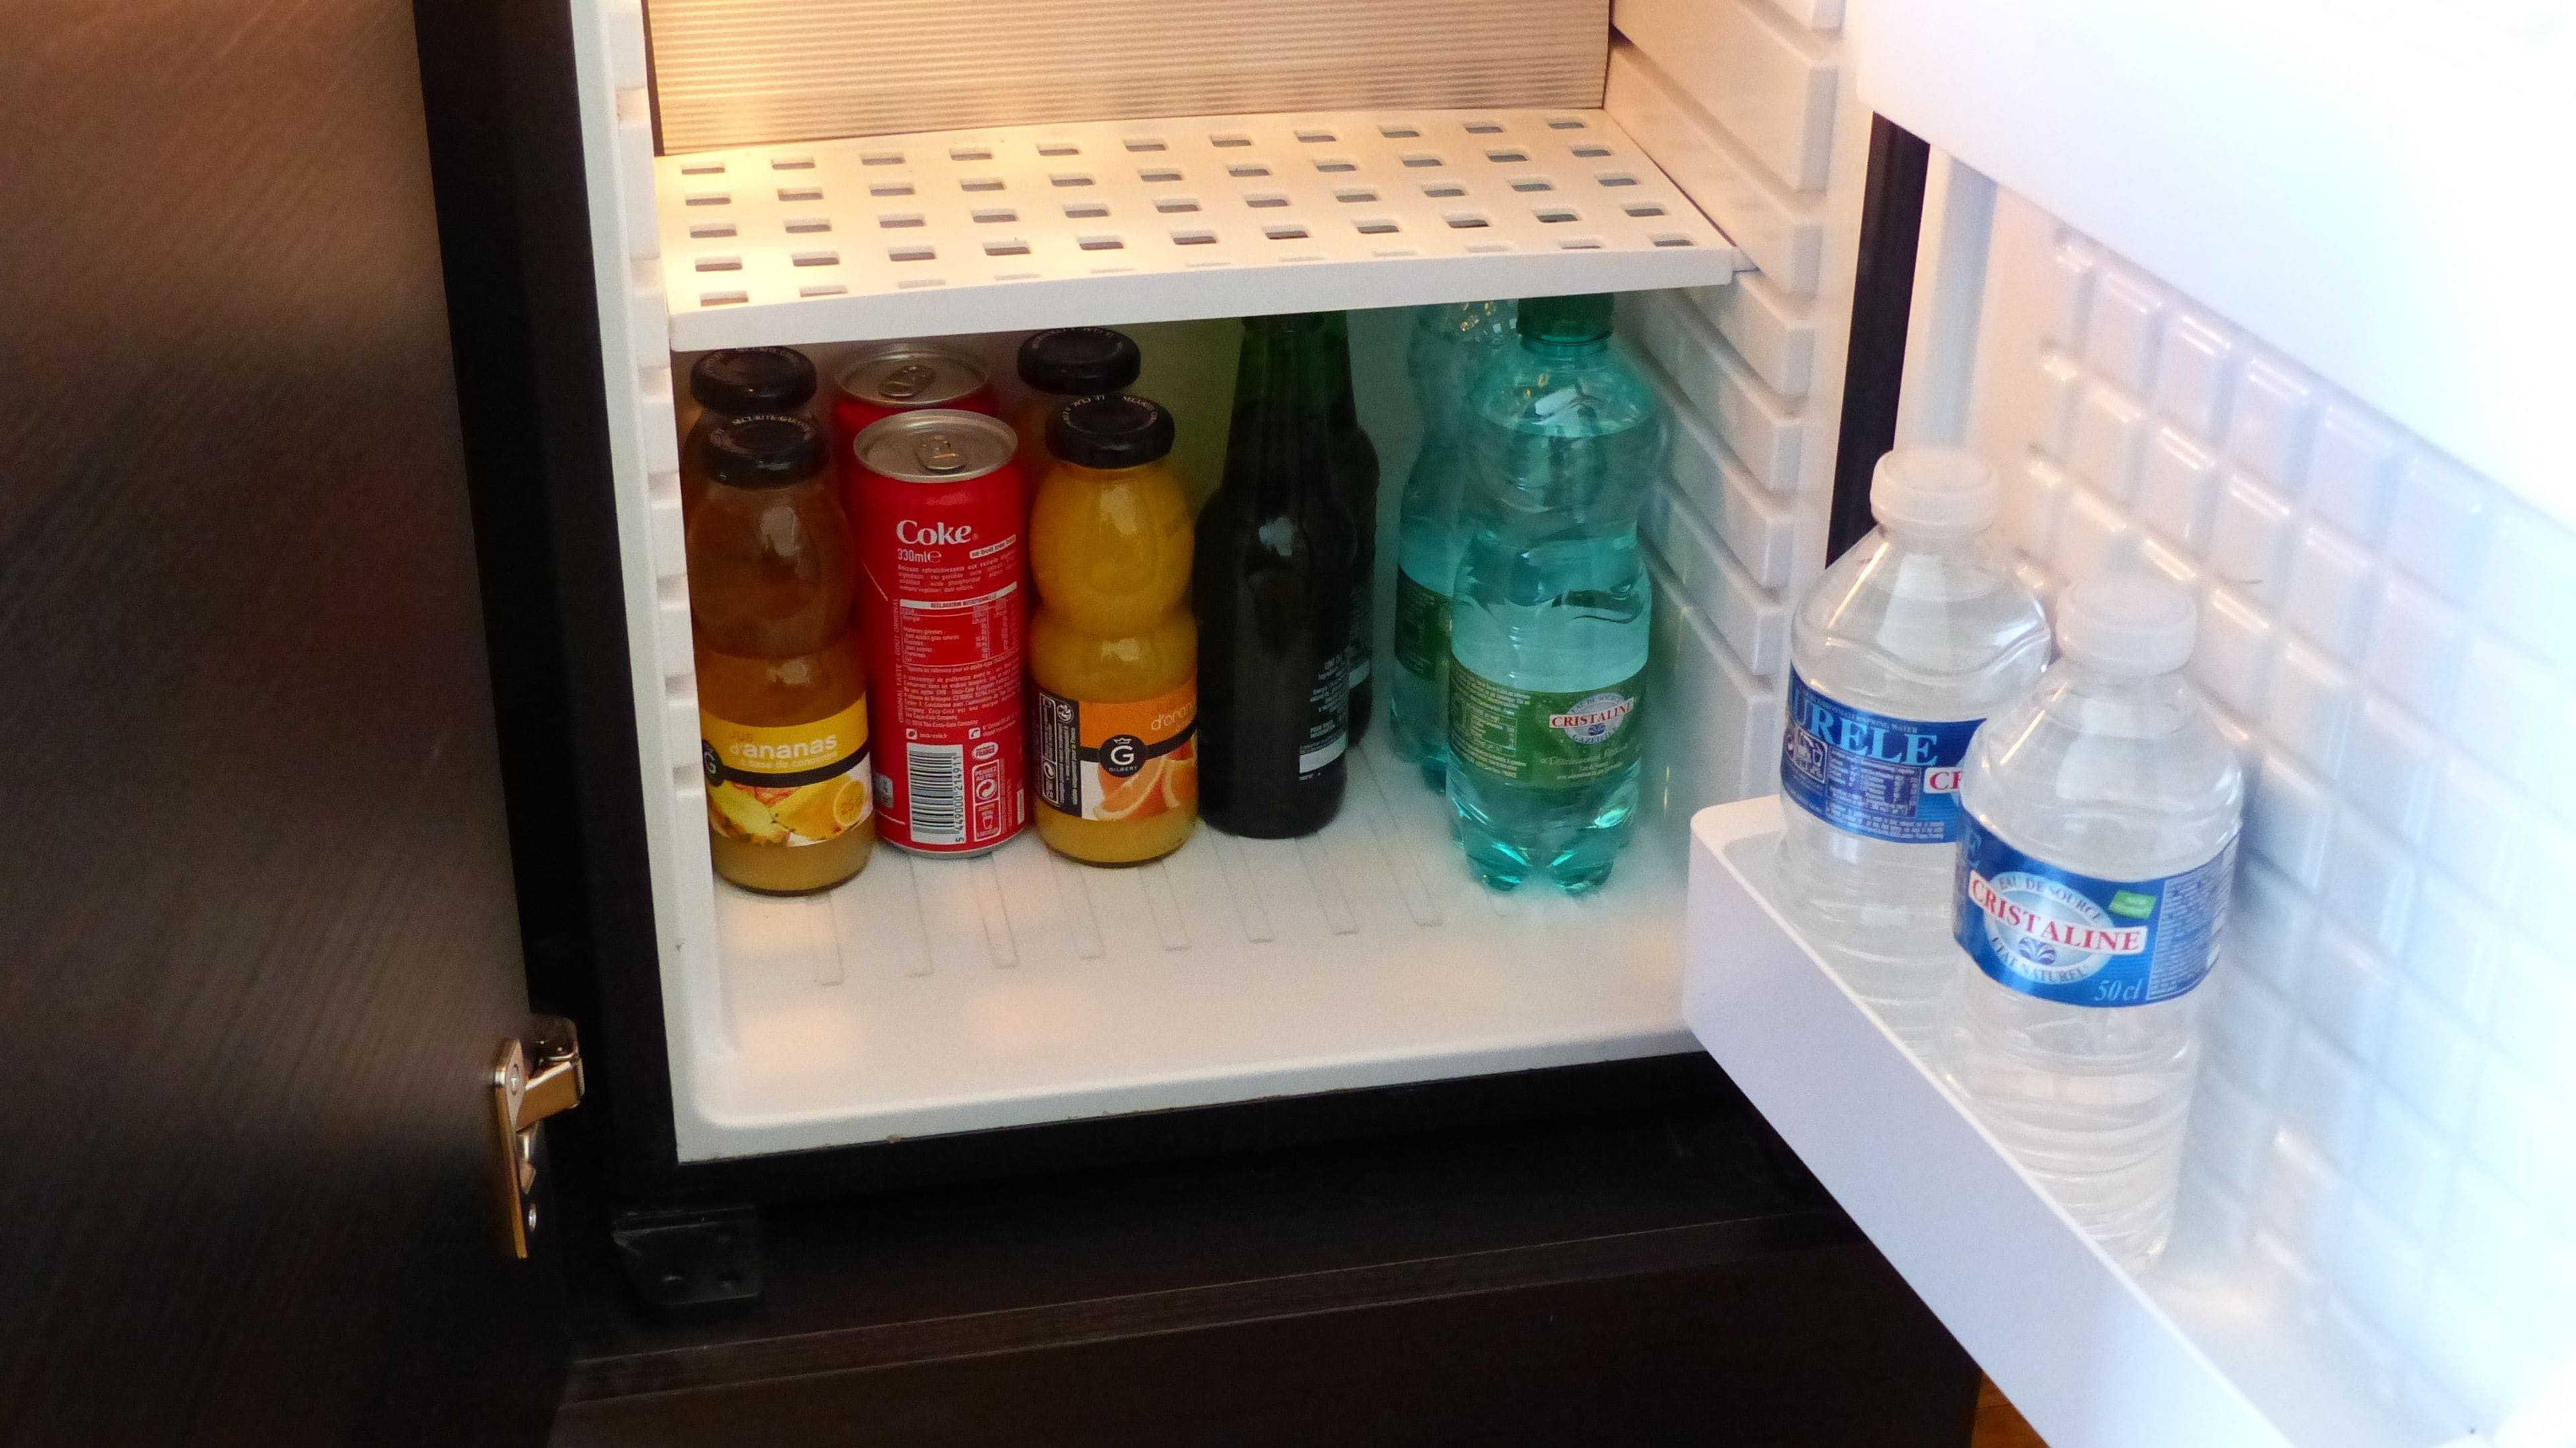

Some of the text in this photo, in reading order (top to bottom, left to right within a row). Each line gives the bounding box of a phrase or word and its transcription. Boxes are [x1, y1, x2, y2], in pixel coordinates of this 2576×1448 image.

[896, 519, 972, 545] Coke
[1552, 701, 1633, 727] CRISTALINE
[1111, 745, 1134, 766] G
[2026, 876, 2044, 891] DE
[2048, 886, 2102, 923] SOURCE
[1972, 879, 2142, 951] CRISTALINE
[2094, 980, 2121, 1001] 50
